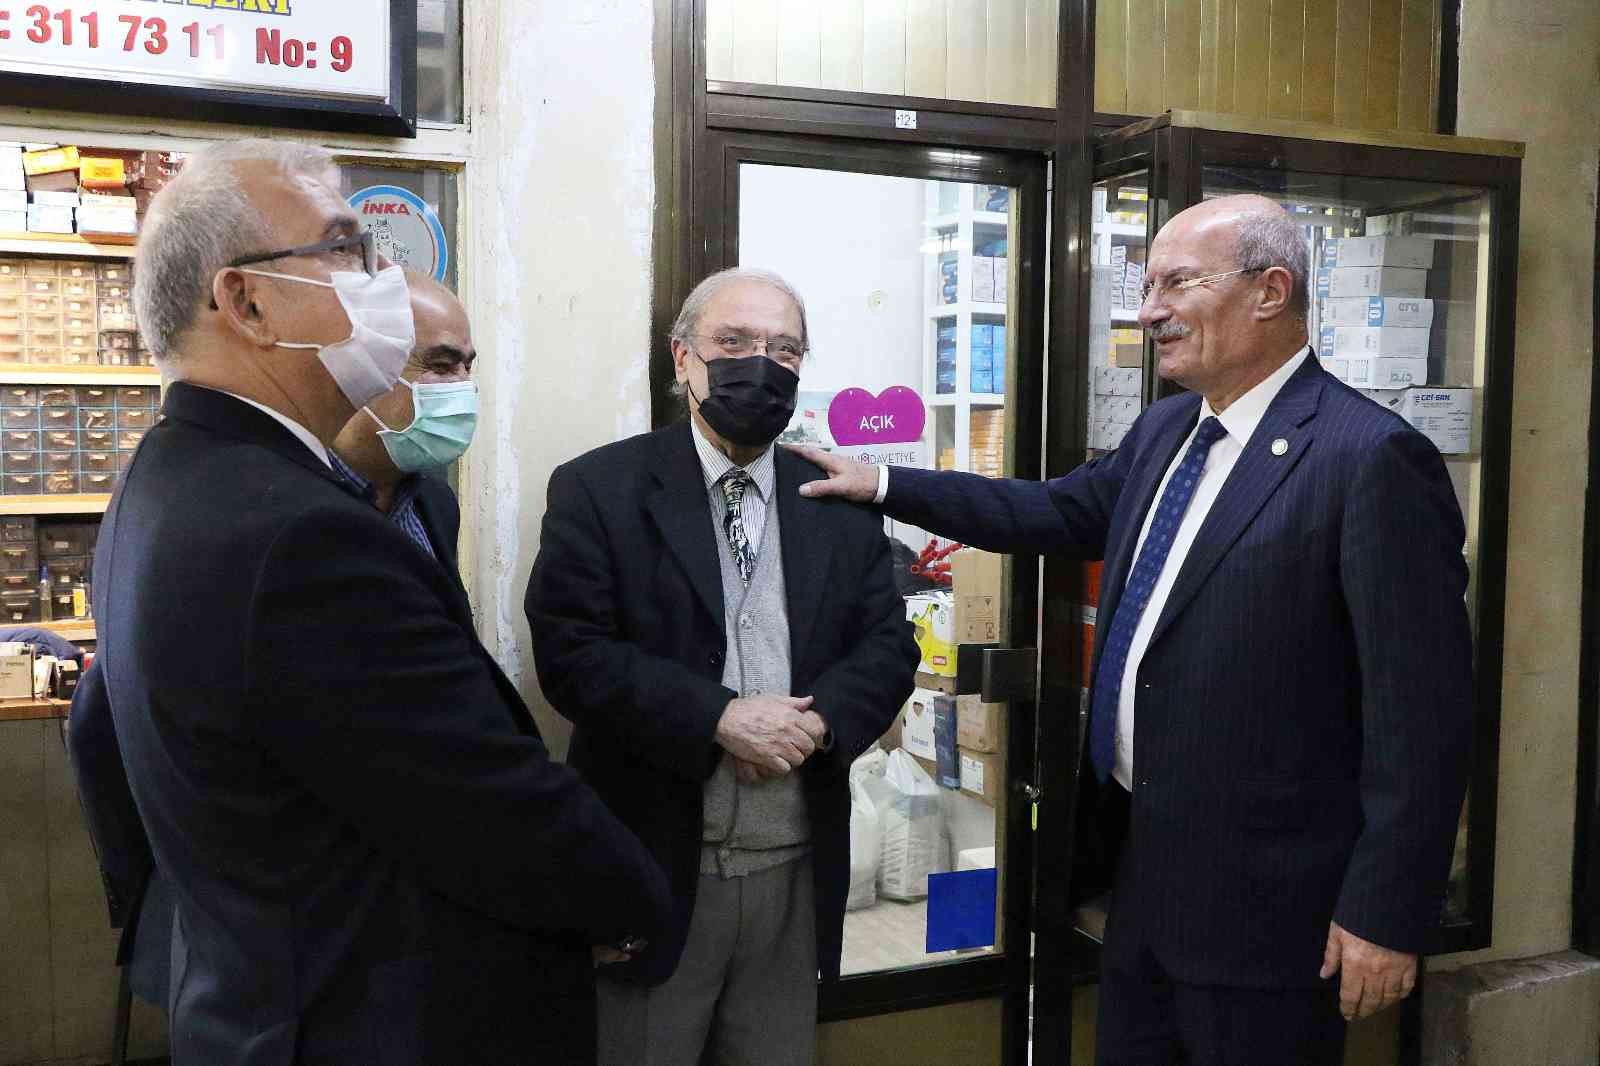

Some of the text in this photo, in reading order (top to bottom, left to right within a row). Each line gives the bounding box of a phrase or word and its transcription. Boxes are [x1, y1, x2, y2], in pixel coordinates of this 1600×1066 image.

[26, 5, 99, 48] 311
[118, 14, 169, 55] 73
[182, 22, 225, 60] 11
[256, 28, 317, 69] No:
[331, 35, 353, 73] 9
[860, 415, 895, 432] AÇIK
